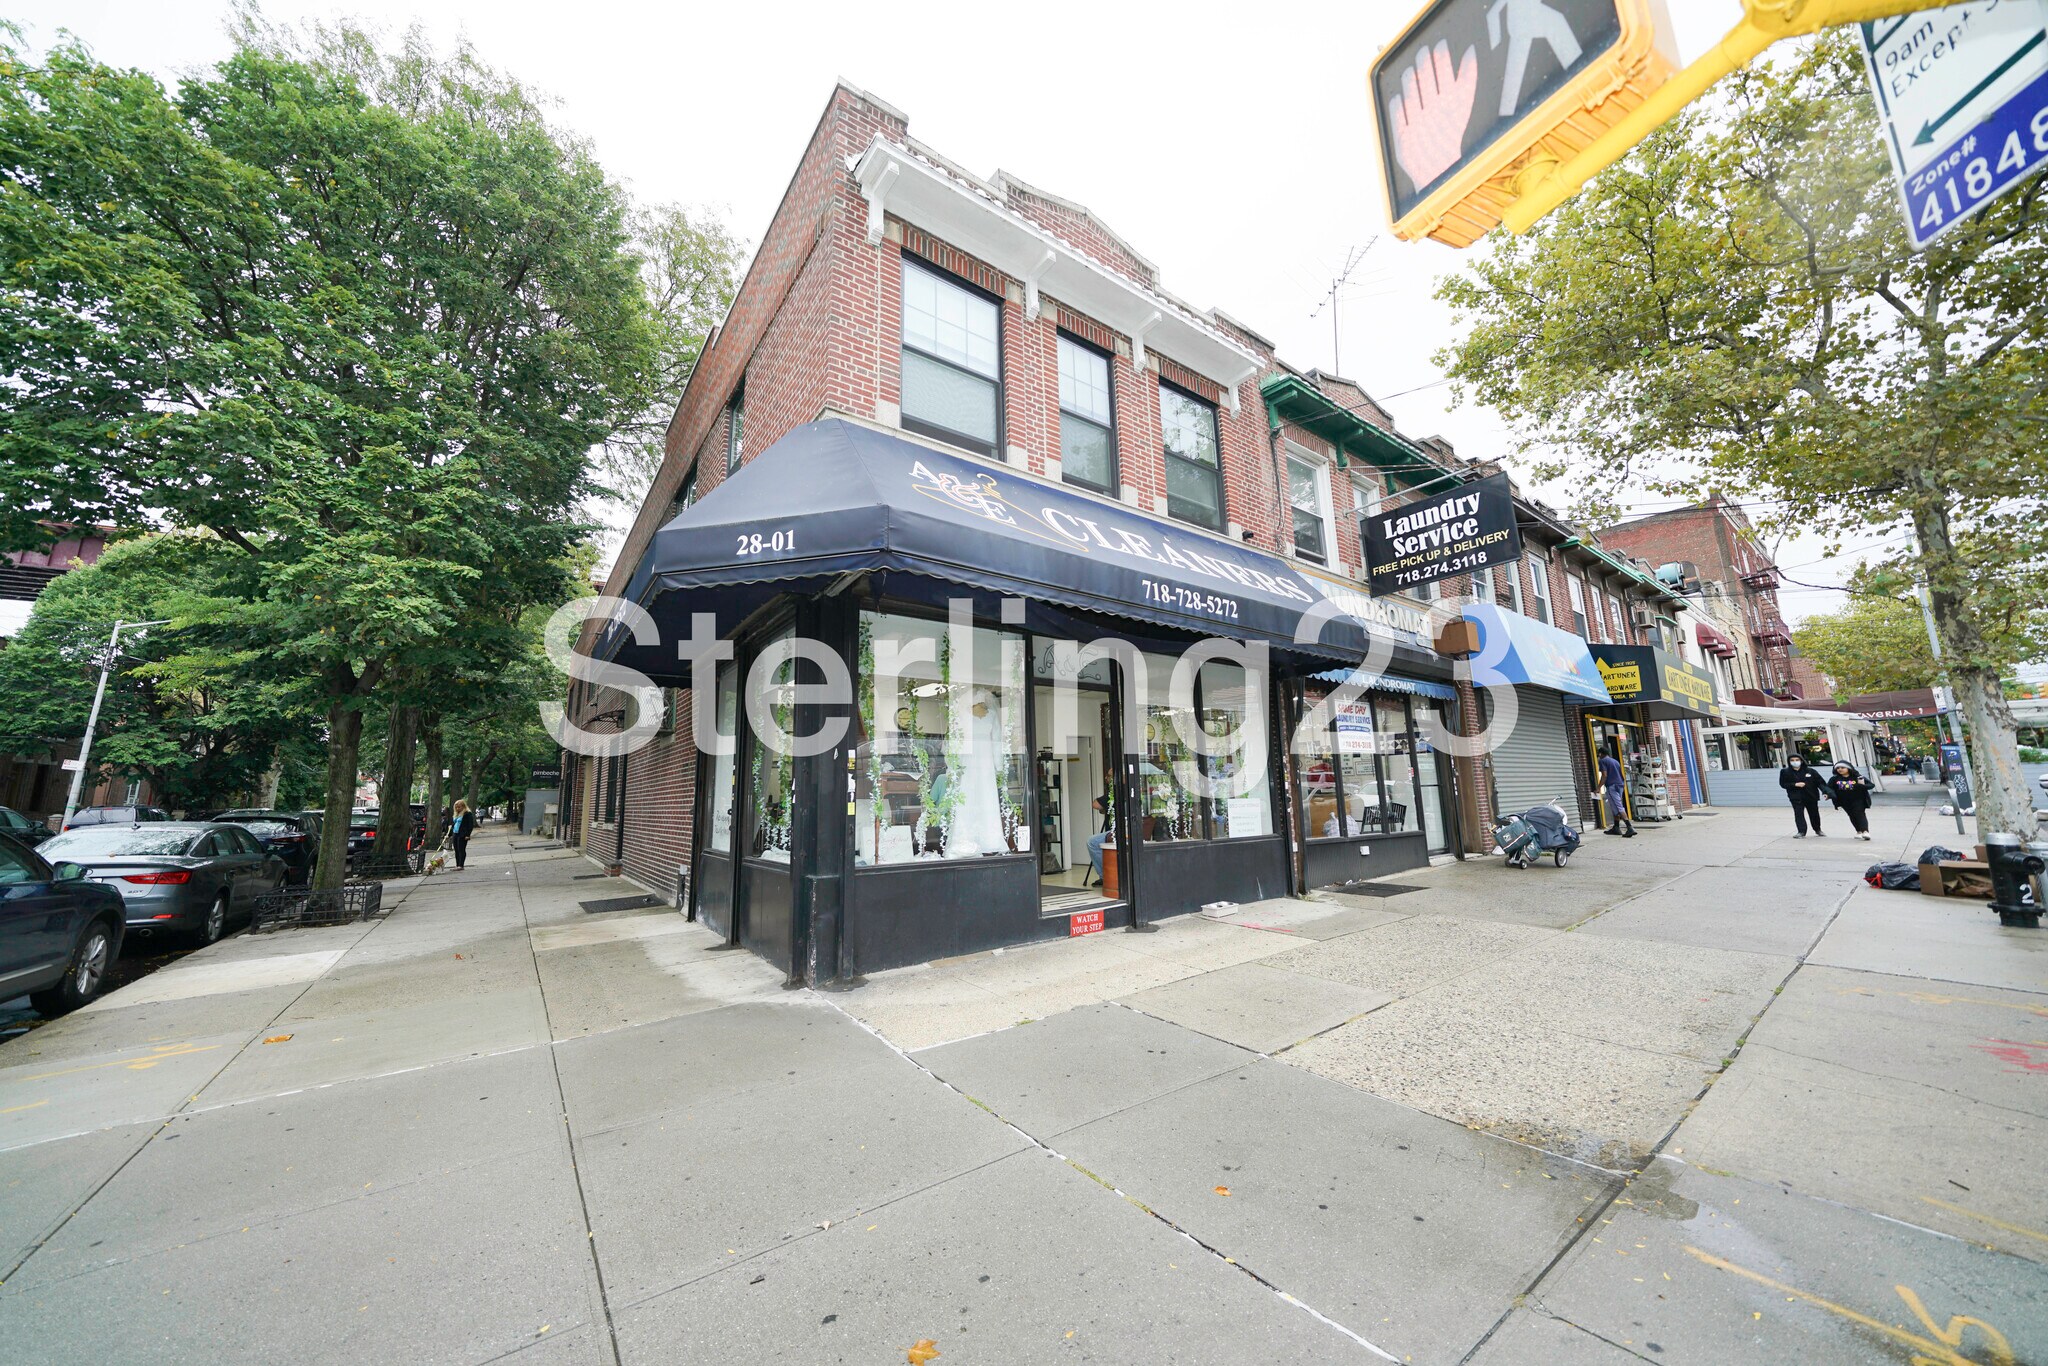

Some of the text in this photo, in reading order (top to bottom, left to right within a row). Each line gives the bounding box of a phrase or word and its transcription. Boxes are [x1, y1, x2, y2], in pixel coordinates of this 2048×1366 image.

[1885, 20, 1934, 74] 9am
[1911, 133, 1978, 197] Zone#
[1383, 492, 1481, 539] Laundry
[736, 529, 796, 556] 28-01
[1042, 507, 1313, 603] CLEANERS
[1373, 529, 1510, 576] FREE PICK UP & DELIVERY
[1393, 518, 1479, 558] Service
[1396, 551, 1487, 585] 718.274.3118
[1141, 580, 1239, 619] 718-728-5272
[1362, 675, 1416, 691] LAUNDROMAT
[2019, 883, 2035, 905] 2
[1072, 922, 1103, 935] YOUR STEP
[1076, 913, 1099, 924] WATCH
